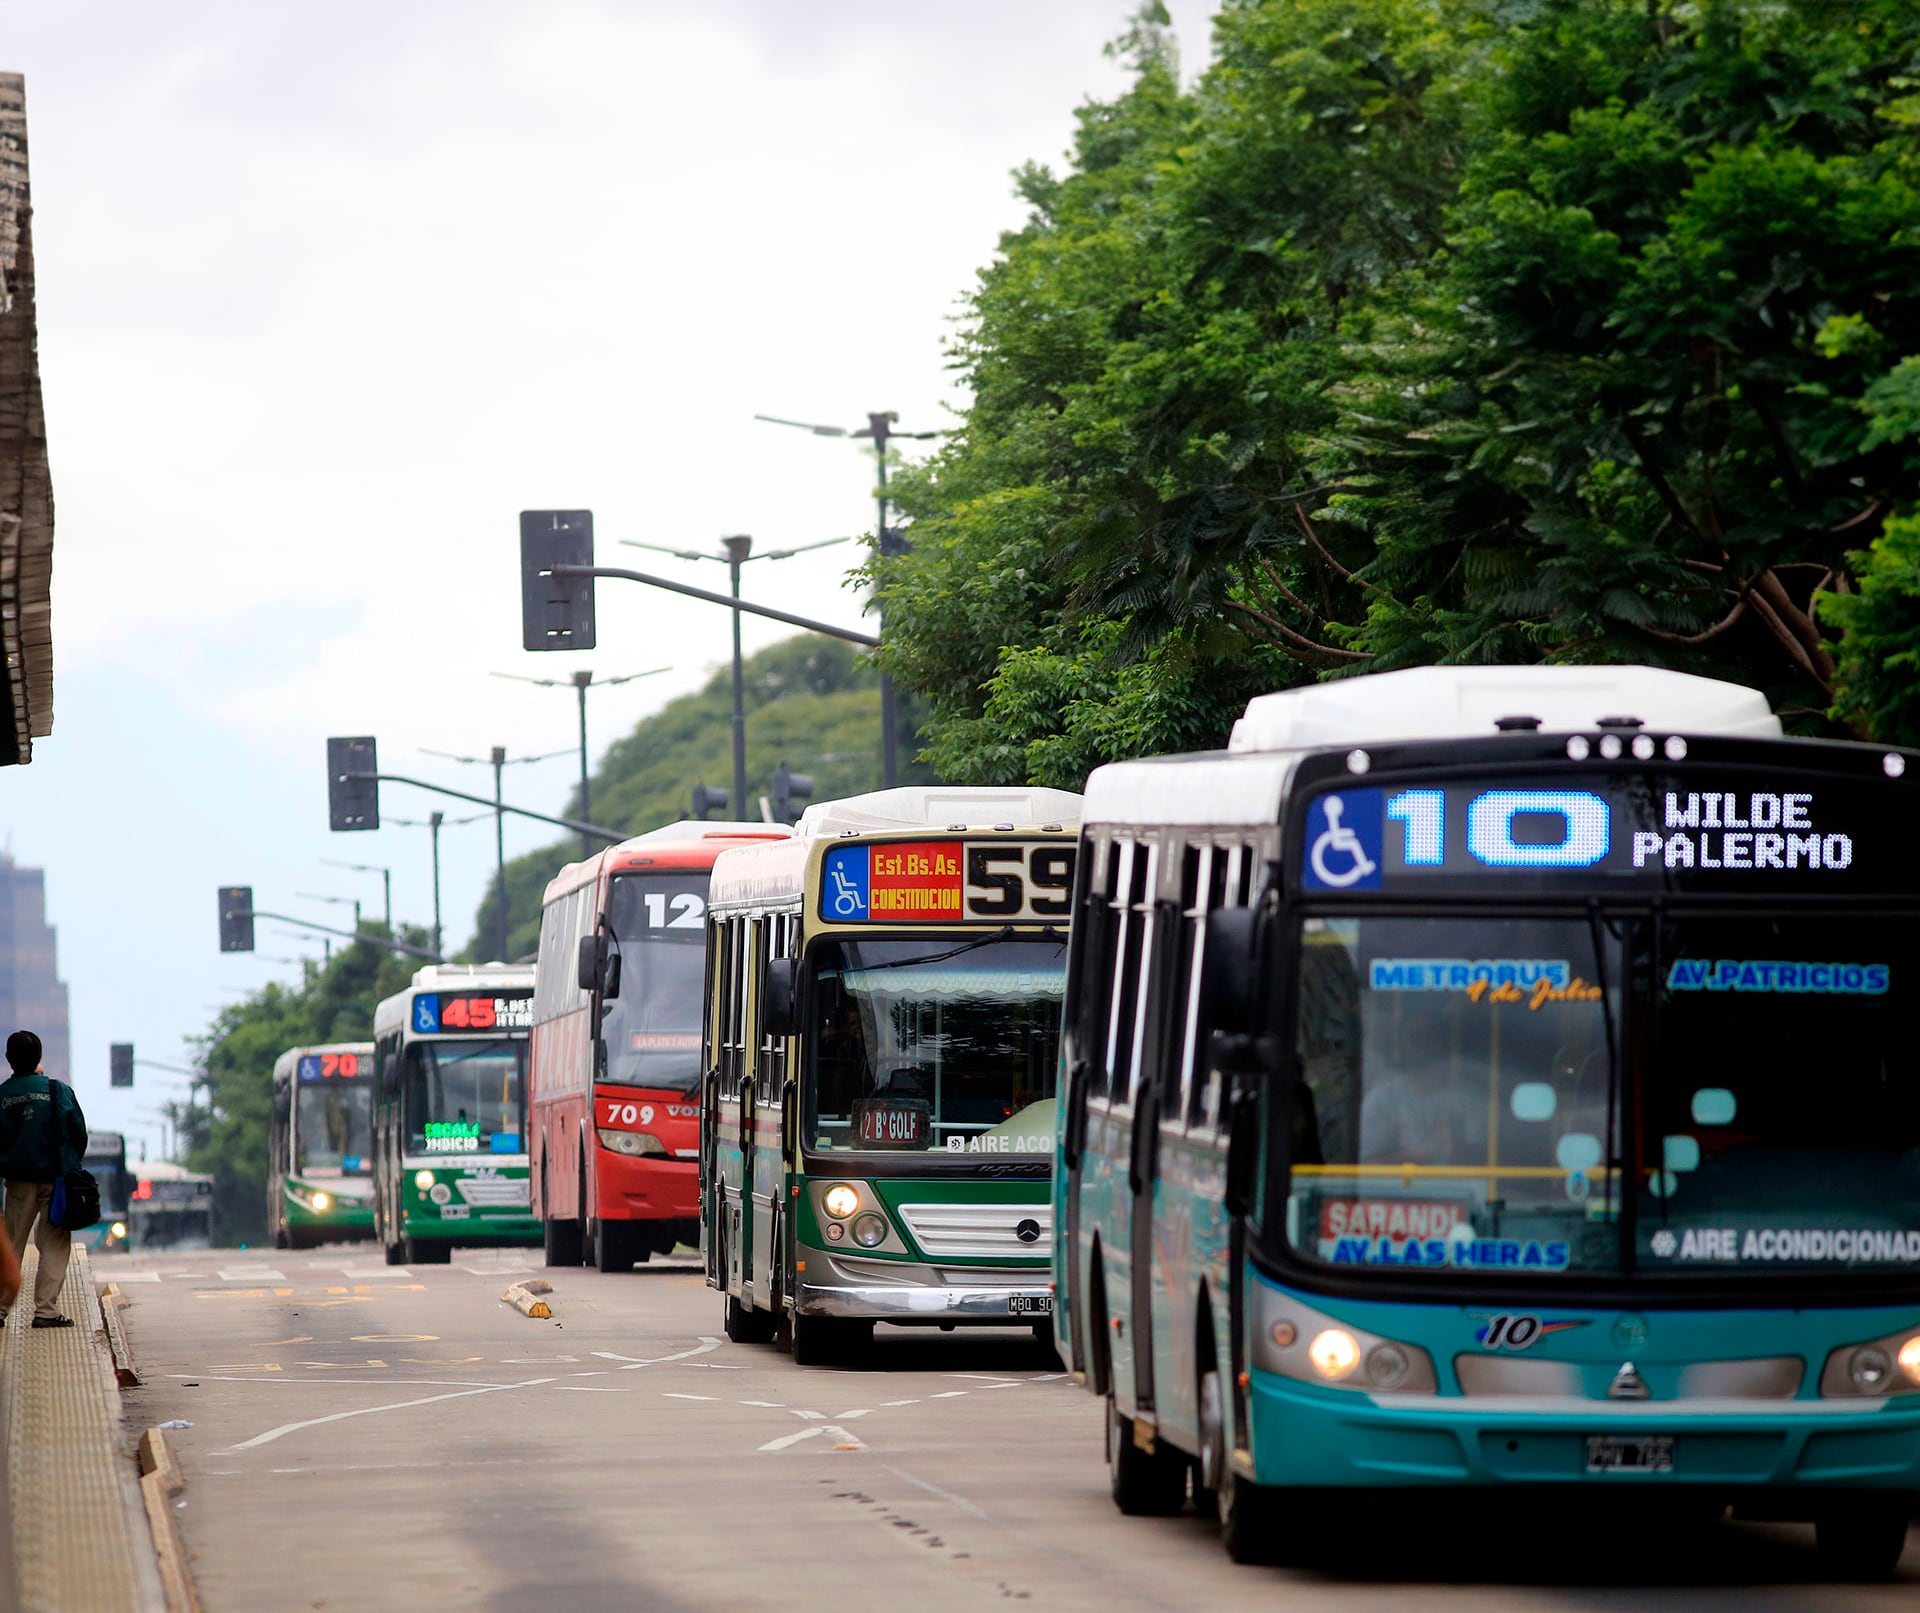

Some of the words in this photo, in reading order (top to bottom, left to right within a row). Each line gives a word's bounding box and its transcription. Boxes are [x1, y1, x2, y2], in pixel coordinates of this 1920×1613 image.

[1665, 791, 1813, 829] WILDE
[1387, 789, 1610, 867] 10
[1632, 831, 1853, 869] PALERMO
[874, 854, 961, 876] Est.Bs.As.
[966, 846, 1077, 916] 59
[644, 893, 705, 929] 12
[870, 888, 961, 910] CONSTITUCION
[1373, 961, 1566, 987] METROBUS
[442, 998, 497, 1028] 45
[321, 1054, 358, 1077] 70
[608, 1104, 655, 1125] 709
[889, 1112, 916, 1139] GOLF
[969, 1136, 1009, 1153] AIRE
[1452, 1239, 1569, 1268] HERAS
[1680, 1229, 1738, 1259] AIRE
[1741, 1229, 1920, 1261] ACONDICIONAD
[1484, 1313, 1543, 1349] 10
